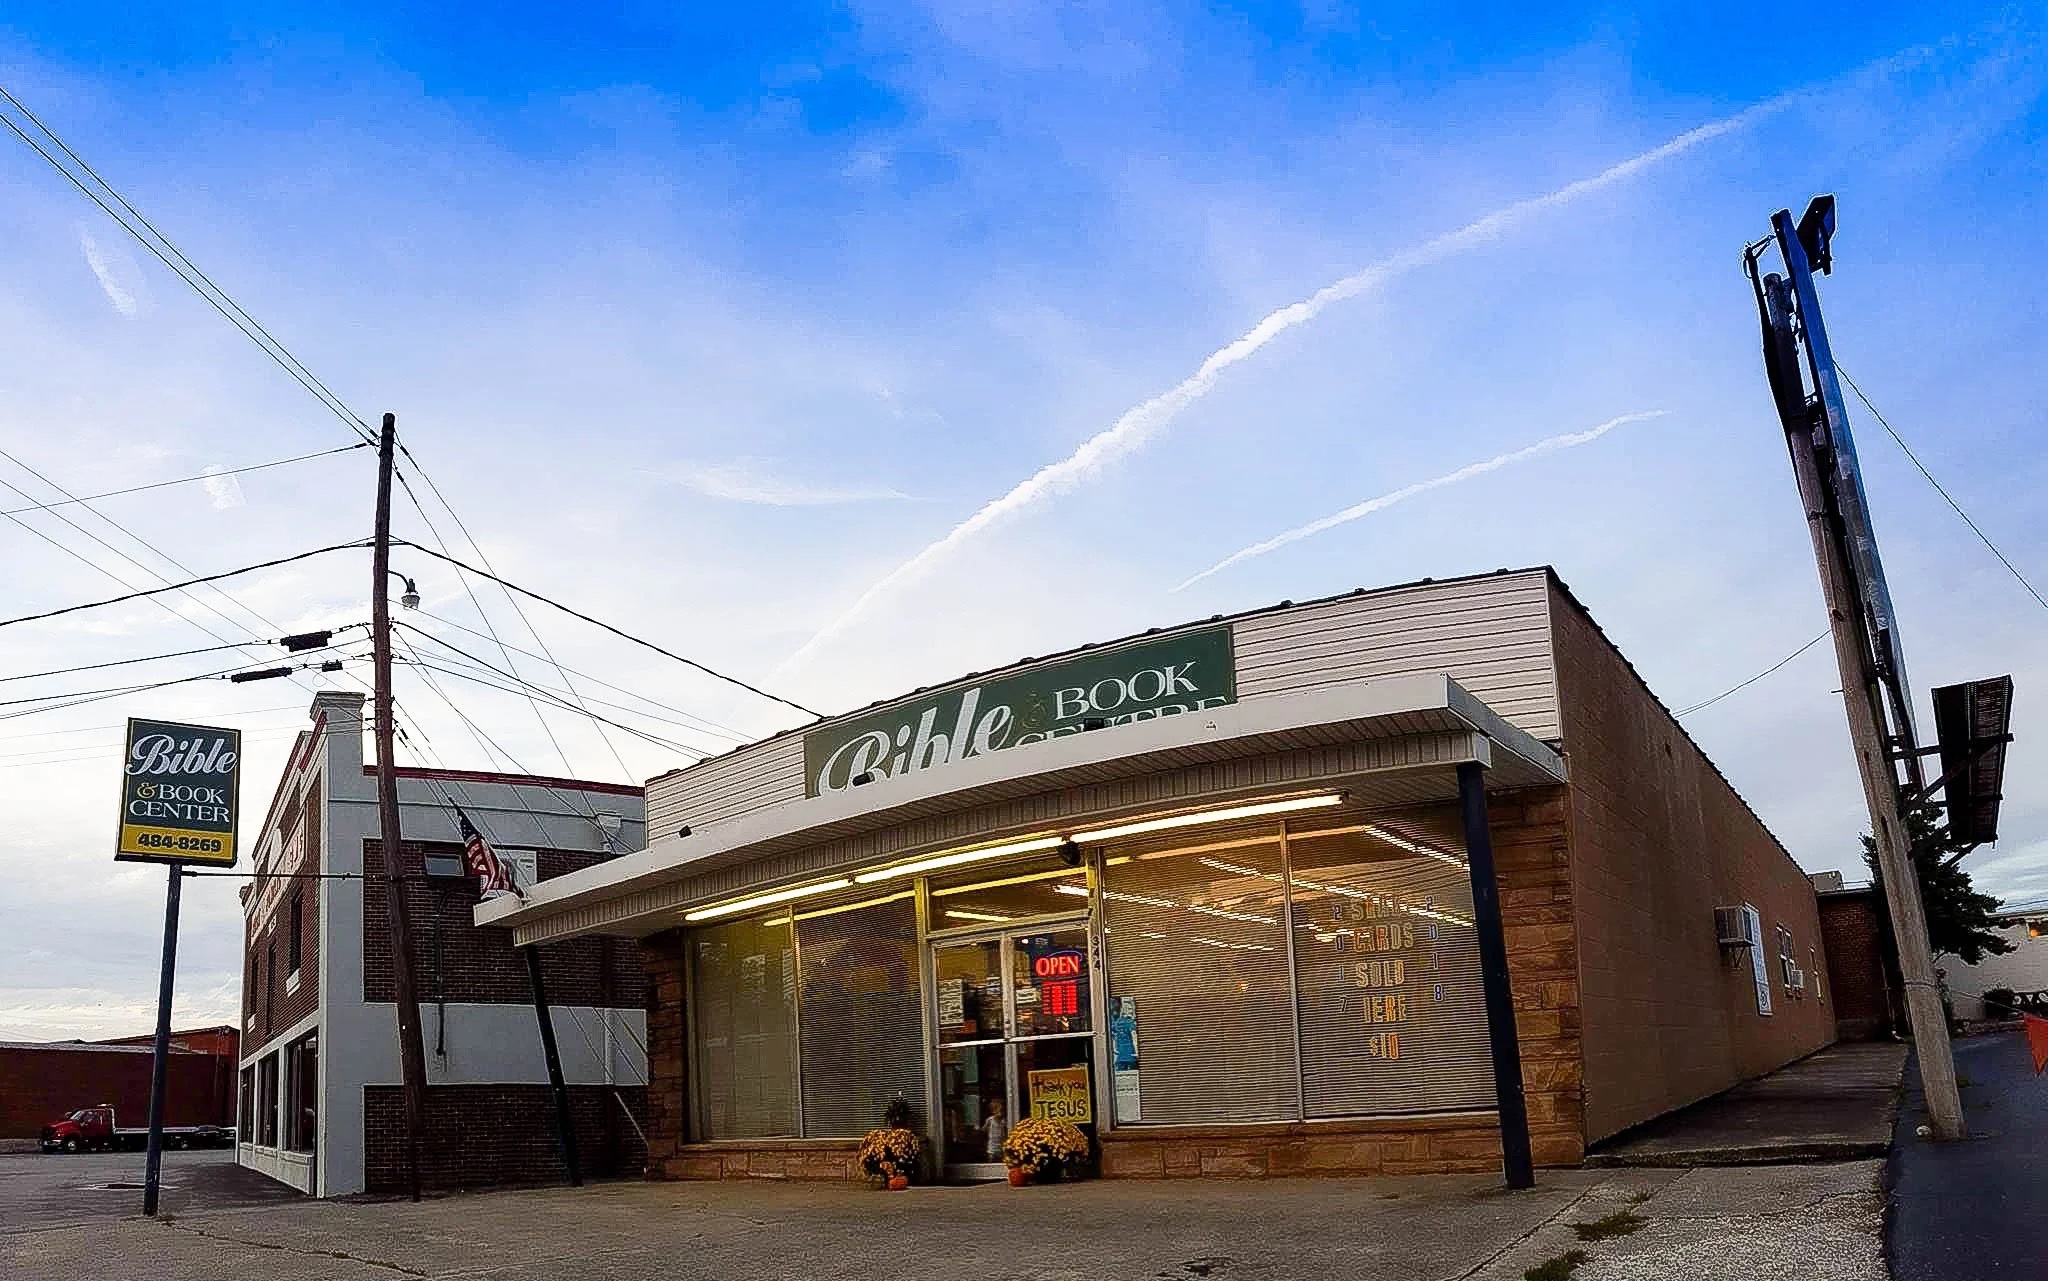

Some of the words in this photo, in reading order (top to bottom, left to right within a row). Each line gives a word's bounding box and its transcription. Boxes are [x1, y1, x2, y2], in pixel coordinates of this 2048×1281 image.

[1055, 661, 1201, 720] BOOK
[125, 734, 237, 775] Bible
[817, 687, 1015, 798] Bible
[137, 782, 158, 799] &
[159, 784, 225, 805] BOOK
[129, 800, 230, 822] CENTER
[138, 833, 222, 852] 484-8269
[1353, 921, 1414, 952] CARDS
[1035, 955, 1080, 977] OPEN
[1356, 960, 1404, 987] SOLD
[1036, 1099, 1087, 1120] JESUS
